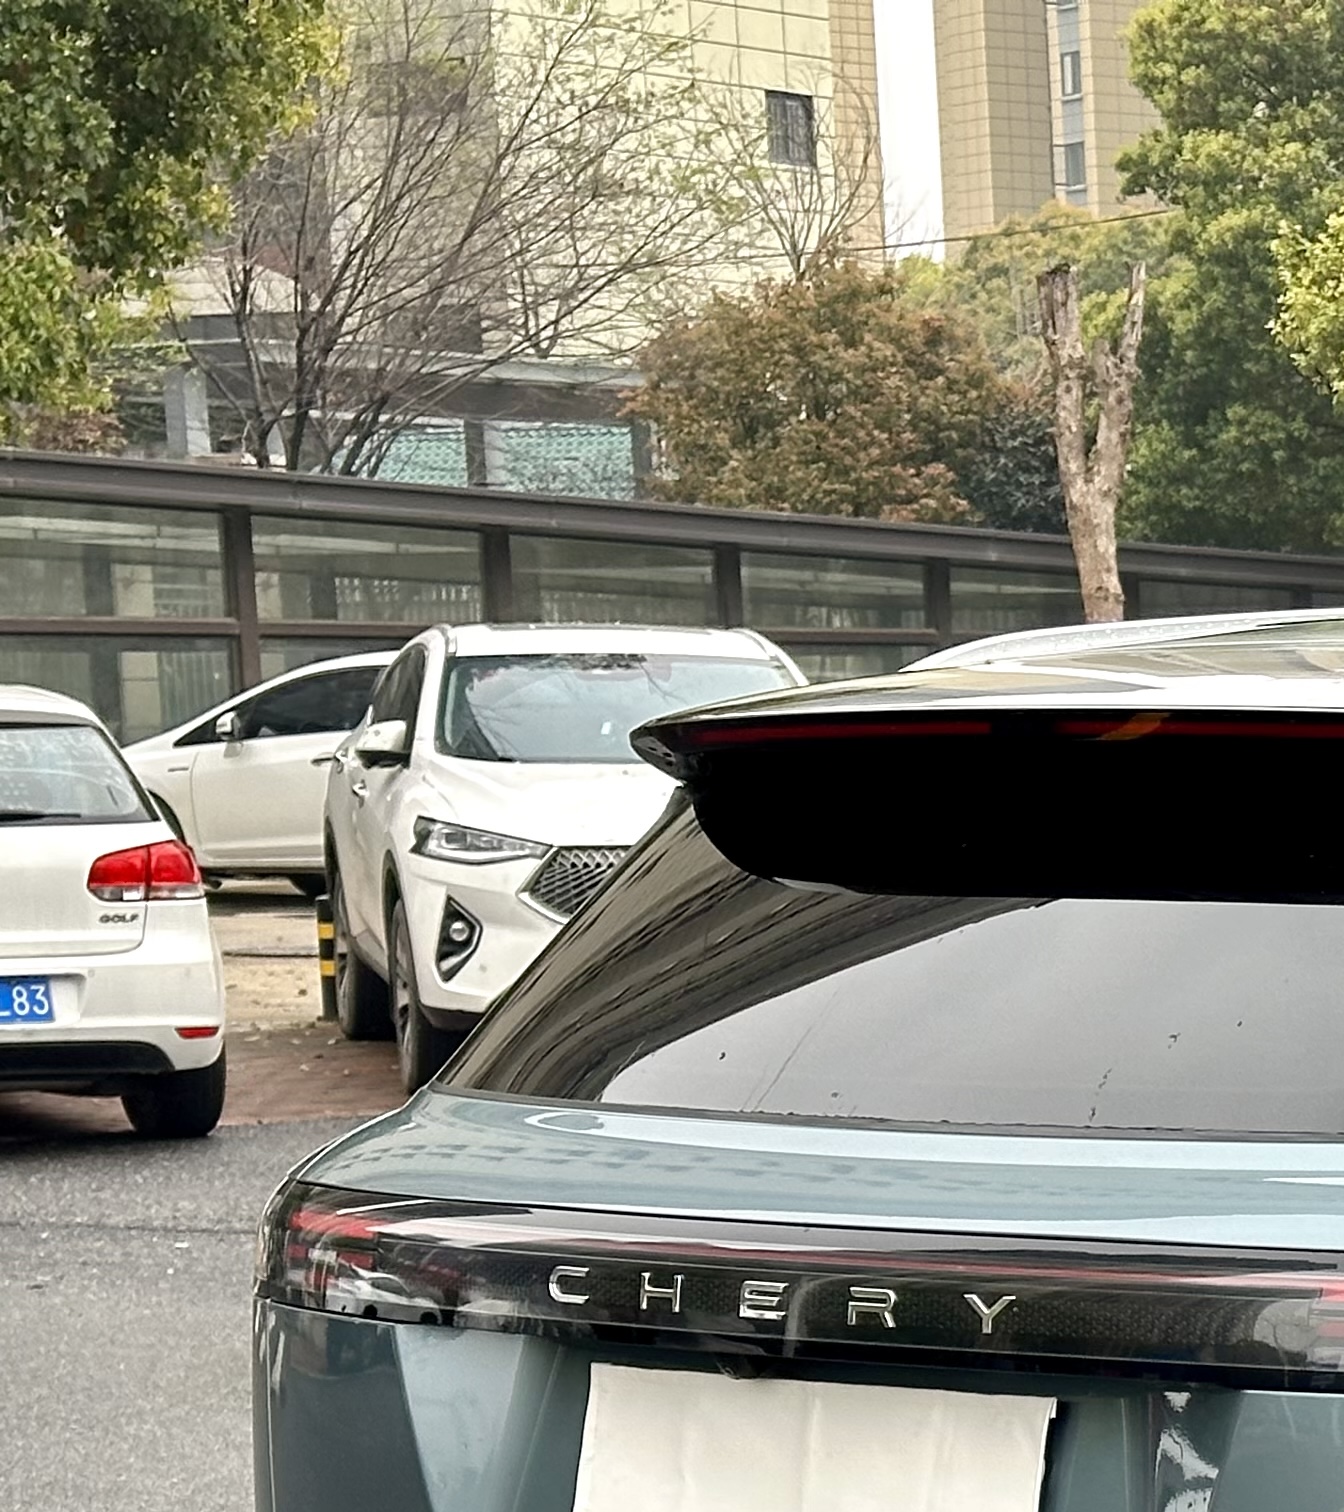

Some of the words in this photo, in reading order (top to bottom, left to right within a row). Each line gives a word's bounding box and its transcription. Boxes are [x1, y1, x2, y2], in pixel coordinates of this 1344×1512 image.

[99, 913, 140, 924] GOLF
[0, 985, 50, 1017] 83
[548, 1264, 1017, 1335] CHERY
